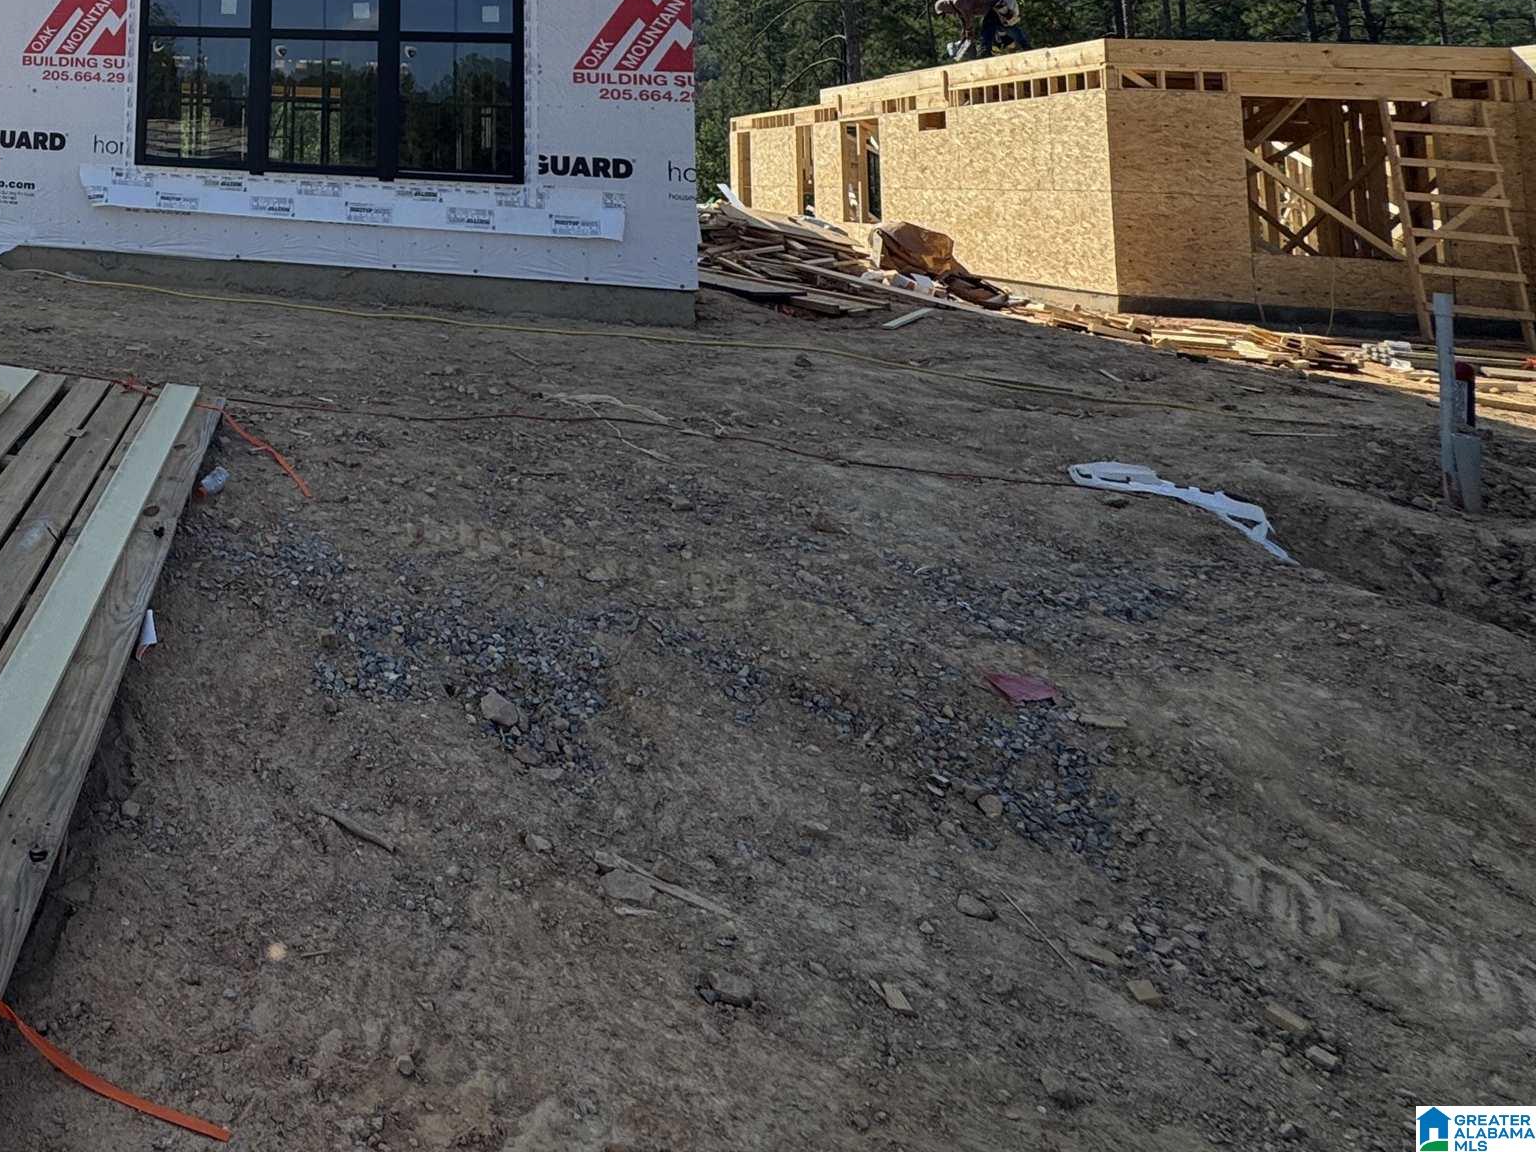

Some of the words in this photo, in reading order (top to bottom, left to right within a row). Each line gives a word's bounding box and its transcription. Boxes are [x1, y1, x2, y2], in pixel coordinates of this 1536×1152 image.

[31, 26, 57, 53] OAK
[22, 55, 97, 68] BUILDING
[102, 56, 125, 69] SU
[583, 38, 614, 68] OAK
[573, 72, 667, 86] BUILDING
